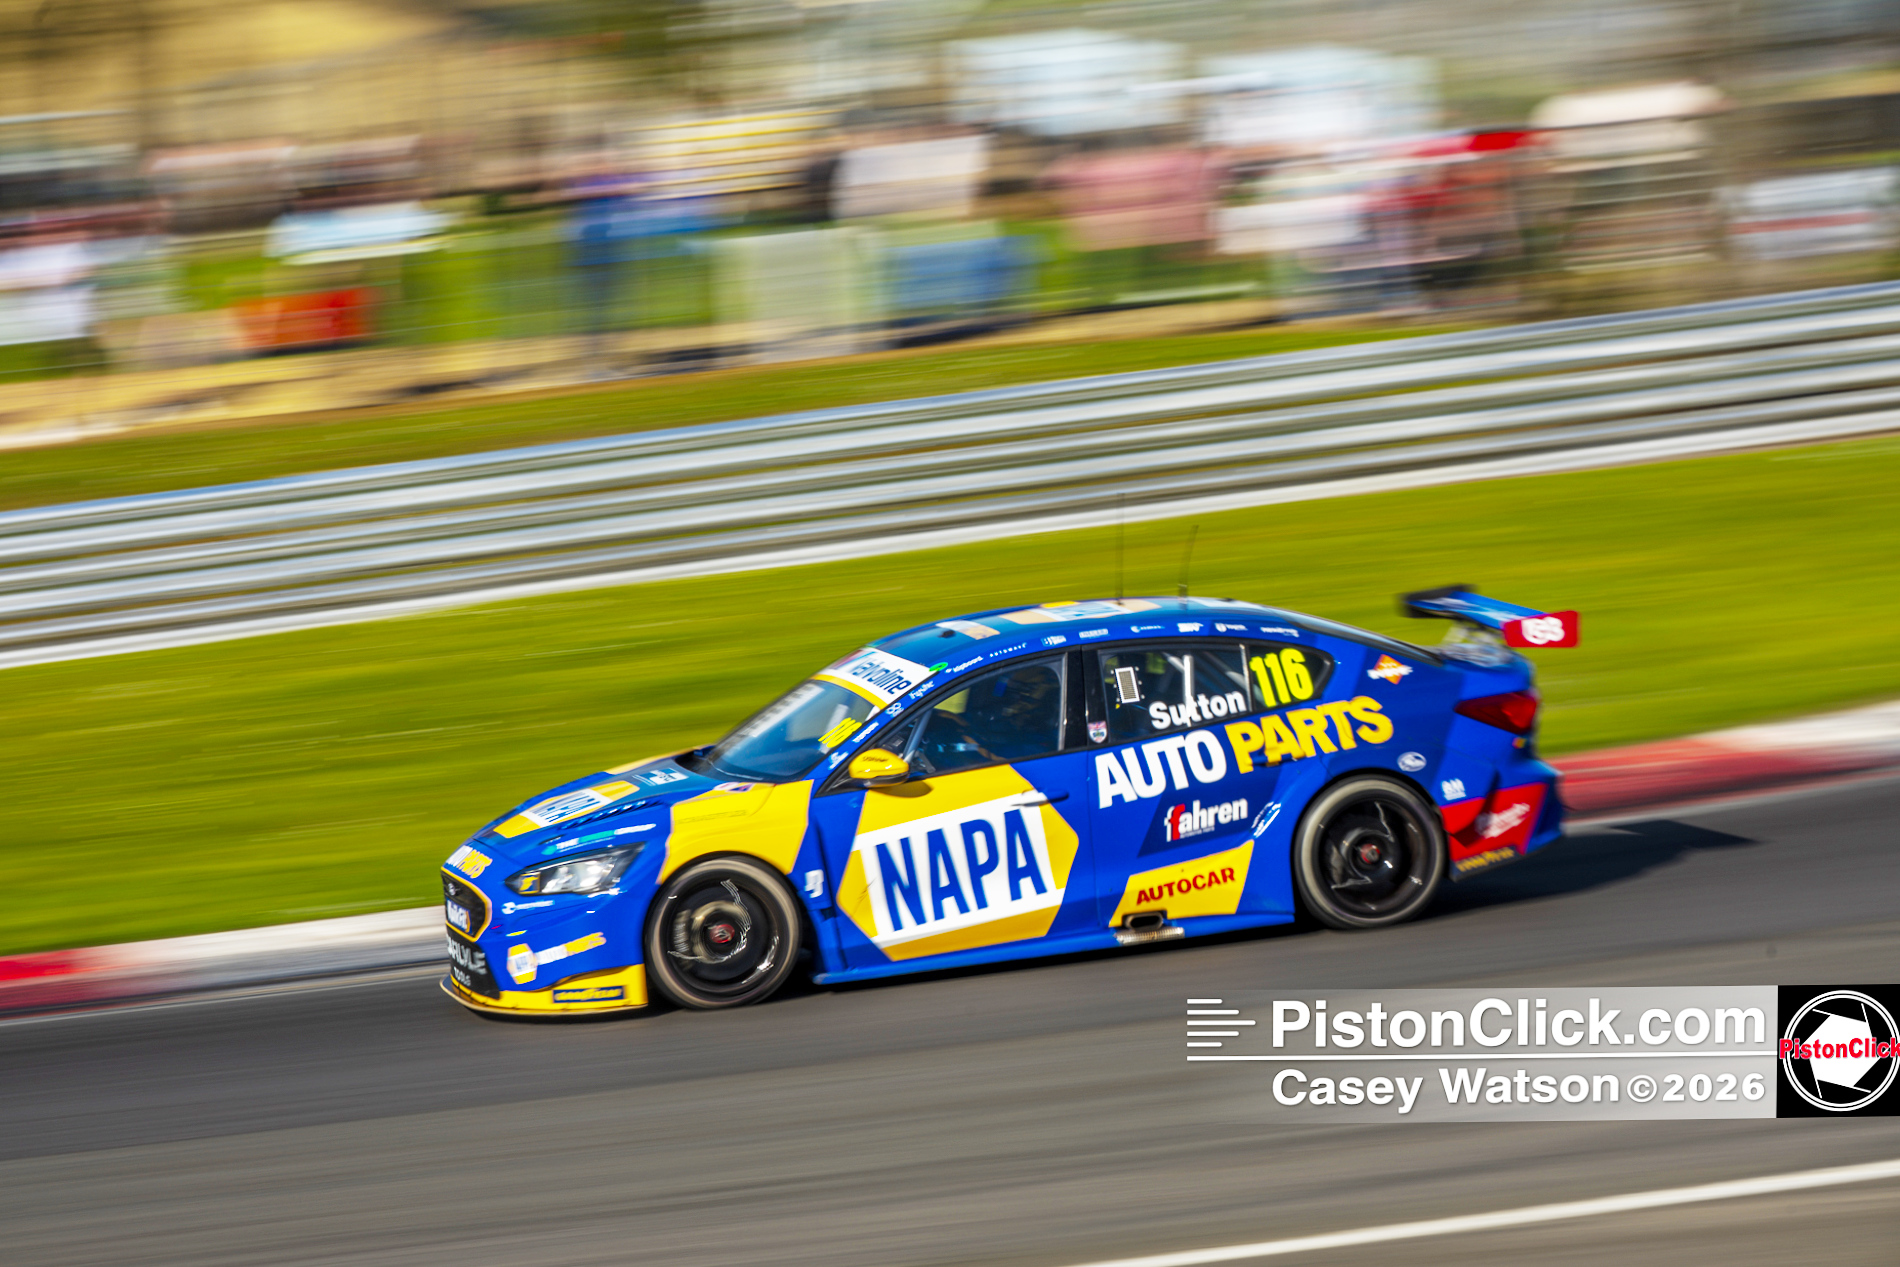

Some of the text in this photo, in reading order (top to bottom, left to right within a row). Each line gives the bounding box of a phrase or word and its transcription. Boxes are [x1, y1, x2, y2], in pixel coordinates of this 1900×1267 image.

[1249, 648, 1314, 708] 116
[1149, 691, 1247, 730] Sutton
[1095, 696, 1394, 809] AUTO PARTS
[1164, 798, 1248, 842] fahren
[875, 808, 1047, 932] NAPA
[1136, 867, 1235, 905] AUTOCAR
